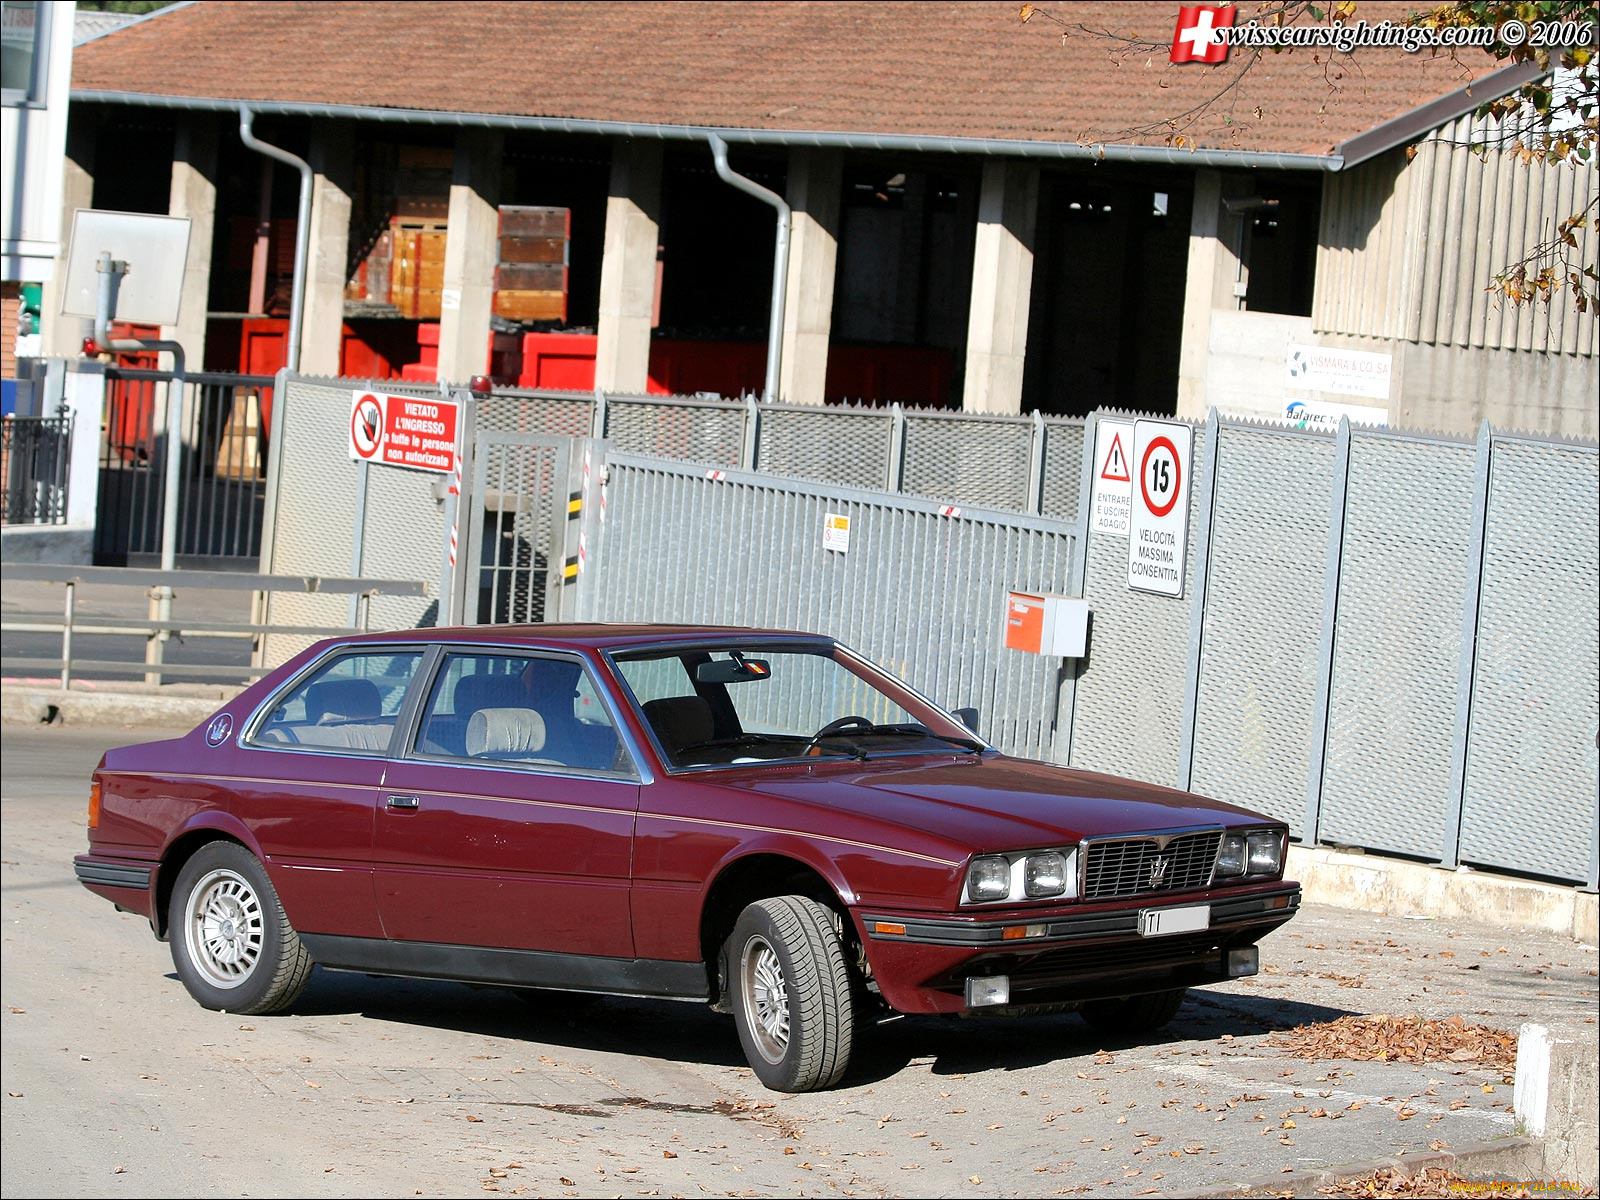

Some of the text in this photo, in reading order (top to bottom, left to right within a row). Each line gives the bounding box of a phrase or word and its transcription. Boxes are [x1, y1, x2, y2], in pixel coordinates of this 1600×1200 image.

[404, 402, 438, 419] VIETATO
[395, 417, 445, 435] L'INGRESSO
[384, 432, 454, 452] a tutte le persone
[387, 448, 449, 467] non autorizzate
[1152, 458, 1170, 493] 15
[1097, 492, 1130, 506] ENTRARE
[1097, 505, 1129, 518] E USCIRE
[1098, 517, 1127, 530] ADAGIO
[1138, 545, 1174, 564] MASSIMA
[1131, 561, 1178, 582] CONSENTITA
